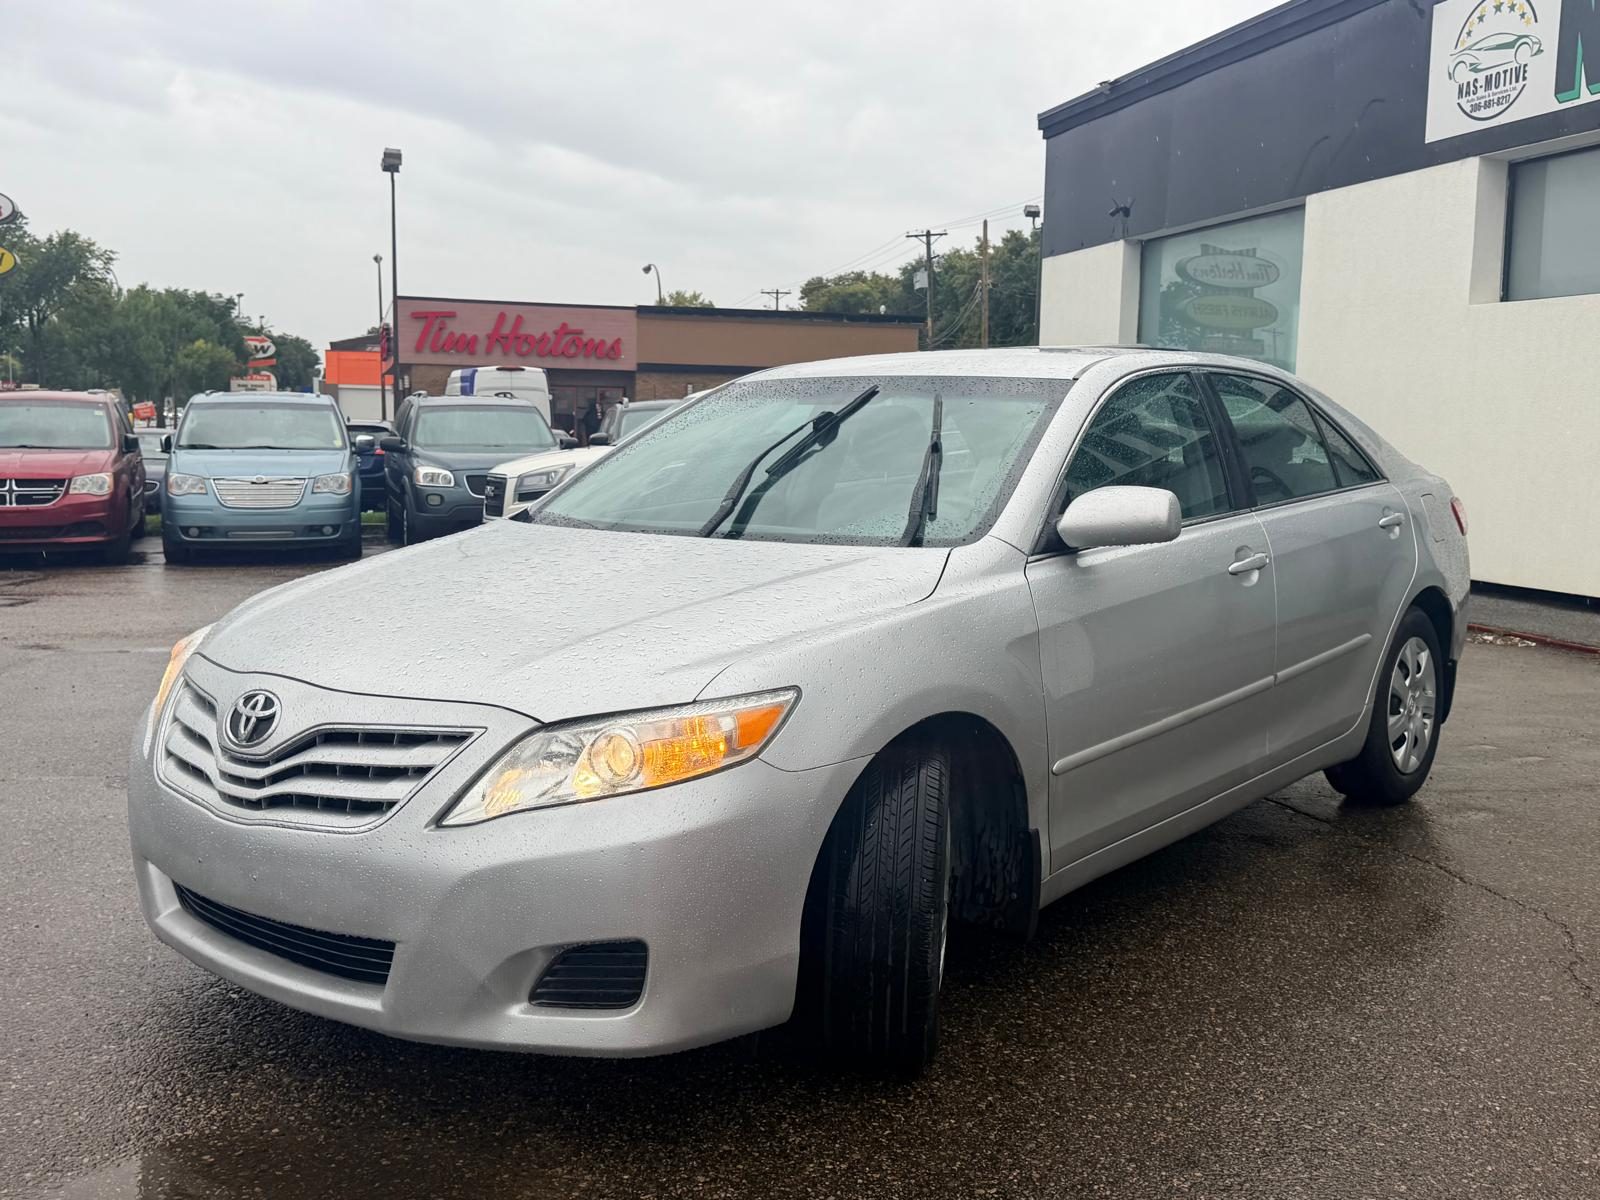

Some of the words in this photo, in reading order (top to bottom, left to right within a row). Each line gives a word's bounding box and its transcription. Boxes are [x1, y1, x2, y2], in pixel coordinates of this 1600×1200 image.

[1457, 63, 1529, 100] NAS-MOTIVE
[410, 311, 478, 355] Tim
[485, 311, 623, 361] Hortons
